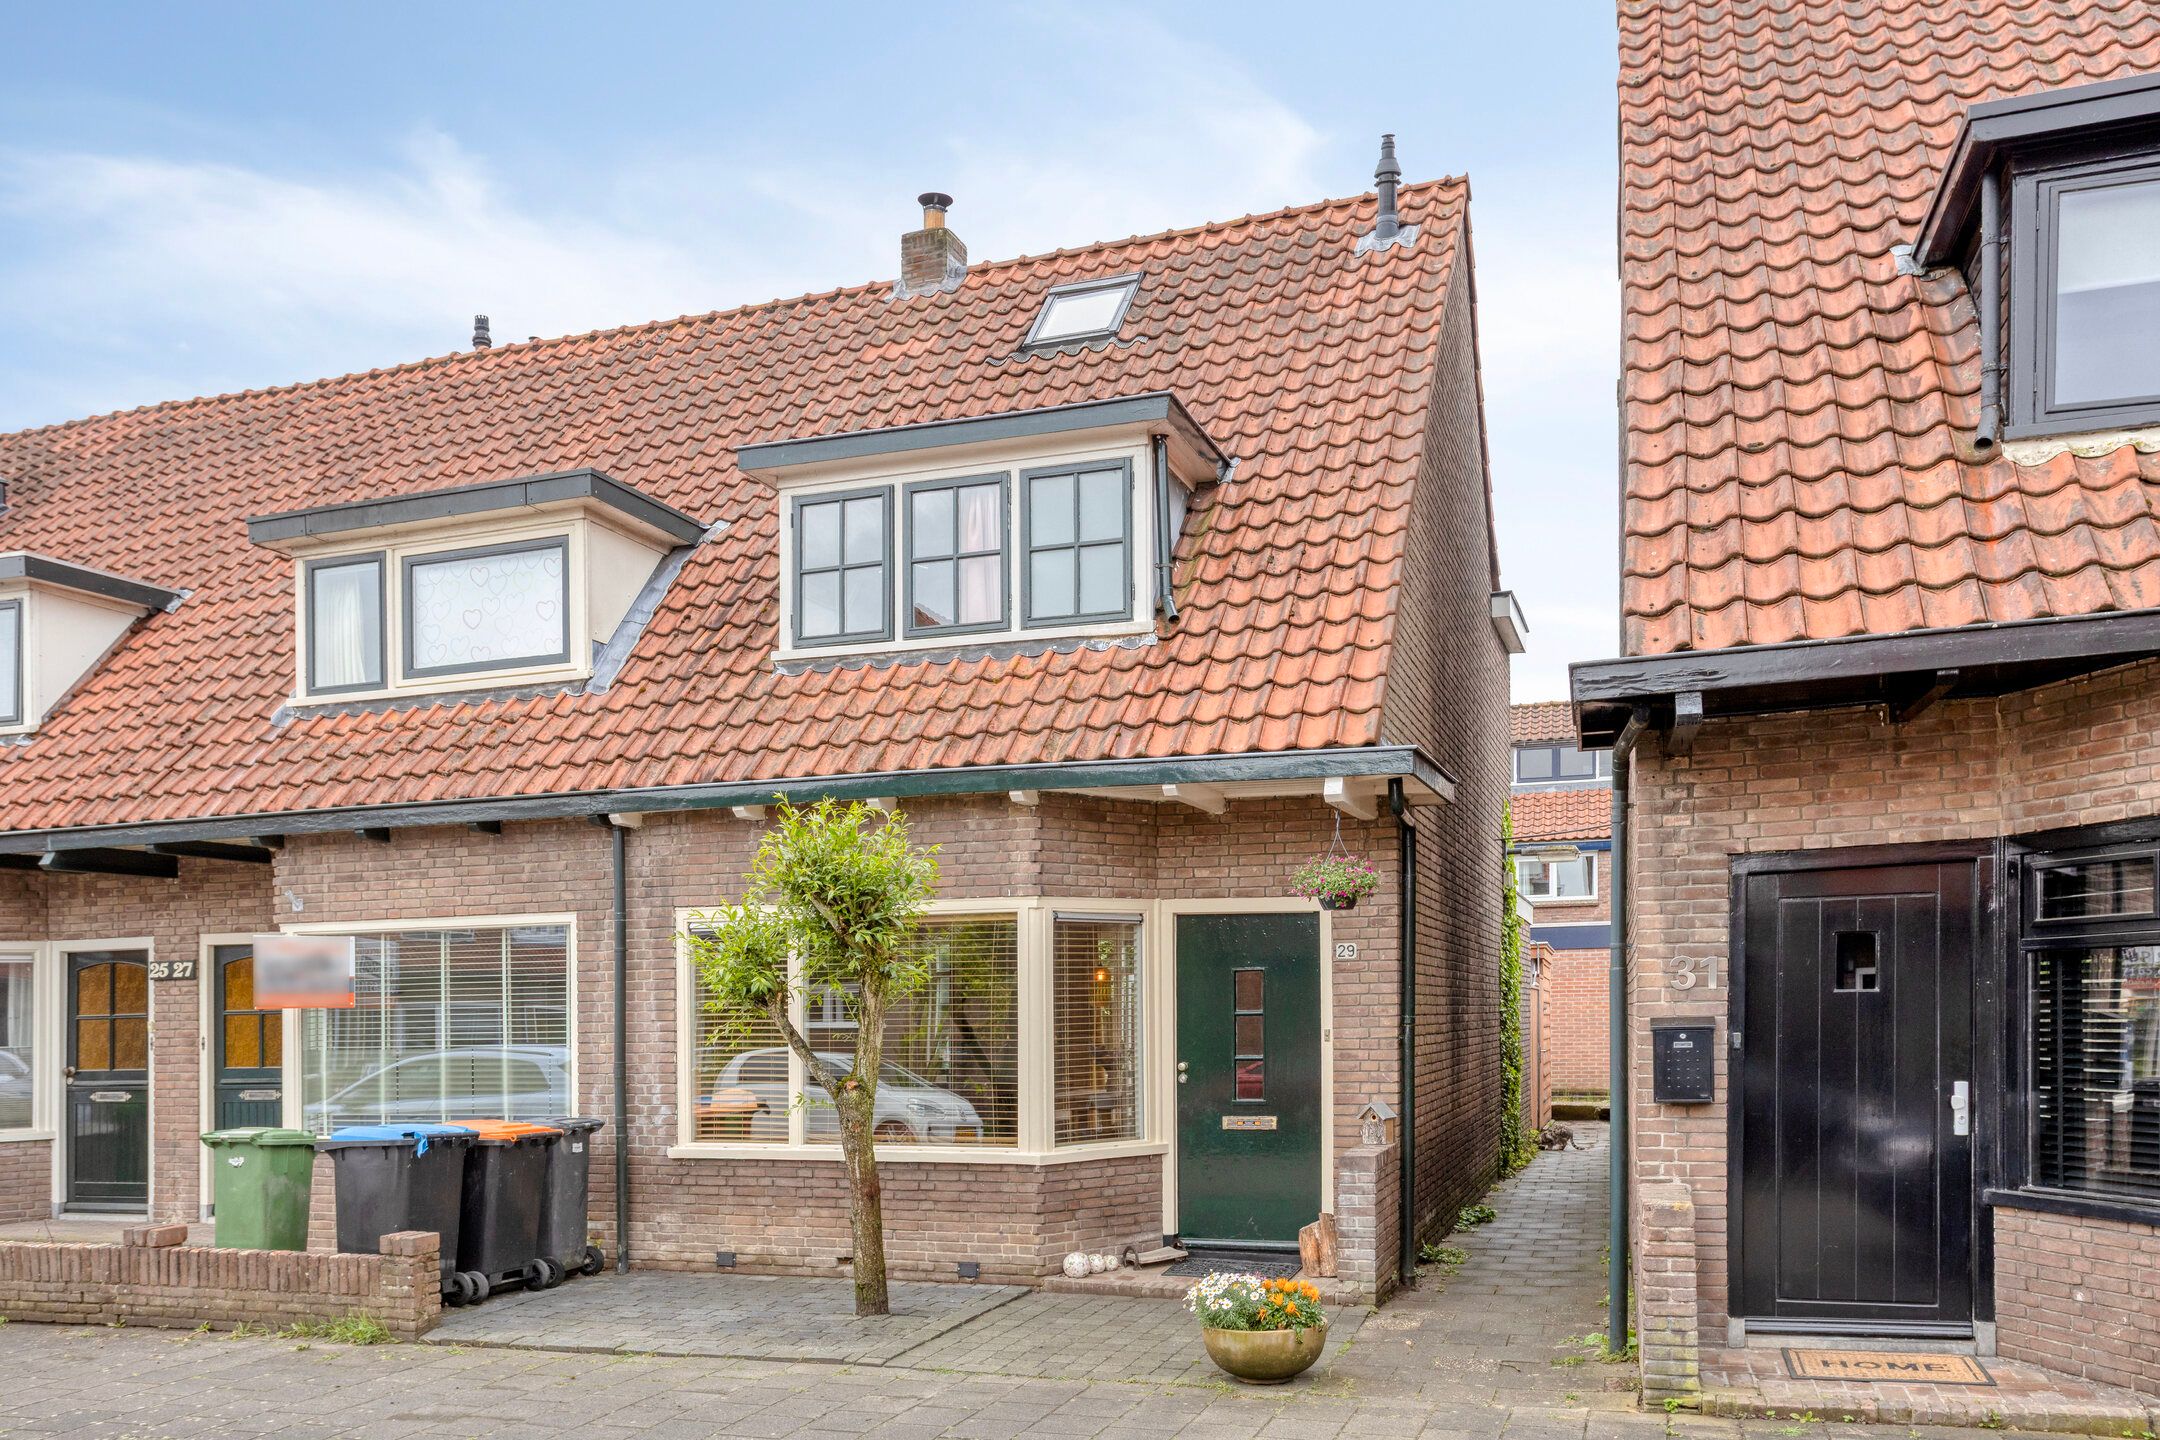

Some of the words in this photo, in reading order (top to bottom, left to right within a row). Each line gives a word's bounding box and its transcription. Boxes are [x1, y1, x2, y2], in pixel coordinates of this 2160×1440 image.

[1337, 944, 1355, 958] 29
[149, 962, 170, 978] 25
[172, 961, 194, 978] 27
[1669, 955, 1718, 991] 31
[1821, 1359, 1951, 1373] HOME
